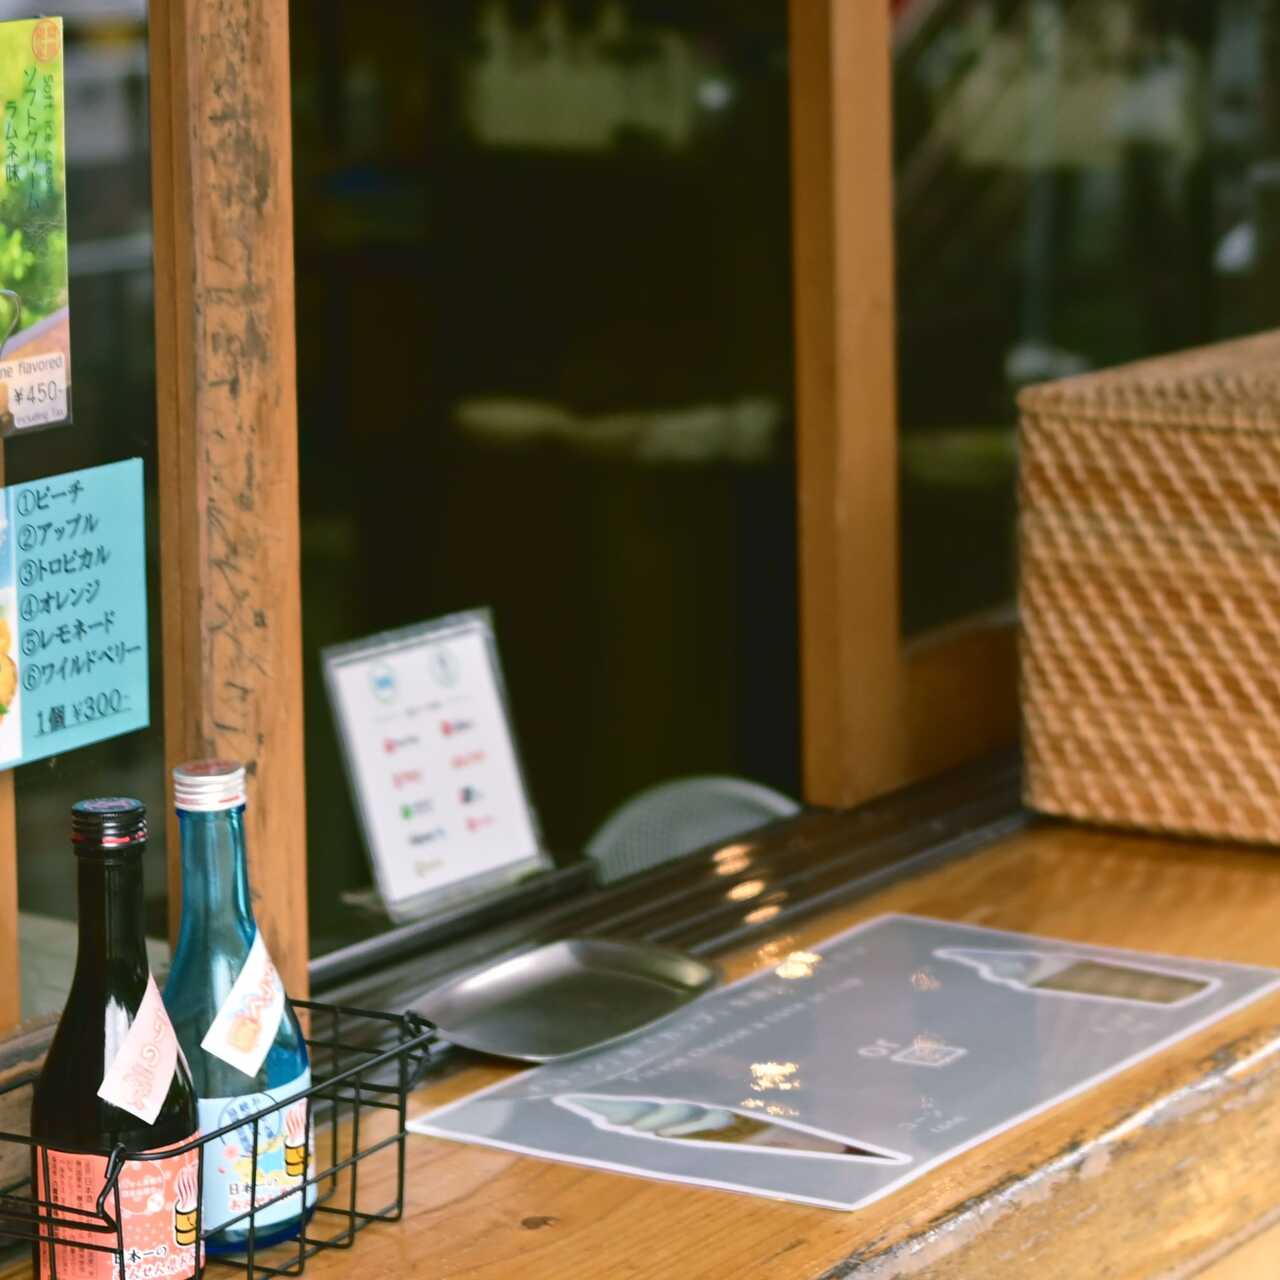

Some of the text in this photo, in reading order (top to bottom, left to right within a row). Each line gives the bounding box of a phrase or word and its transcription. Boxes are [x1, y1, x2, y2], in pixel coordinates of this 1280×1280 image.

[5, 100, 20, 183] ラムネ味
[23, 64, 40, 209] ソフトクリーム
[18, 356, 64, 376] flavored
